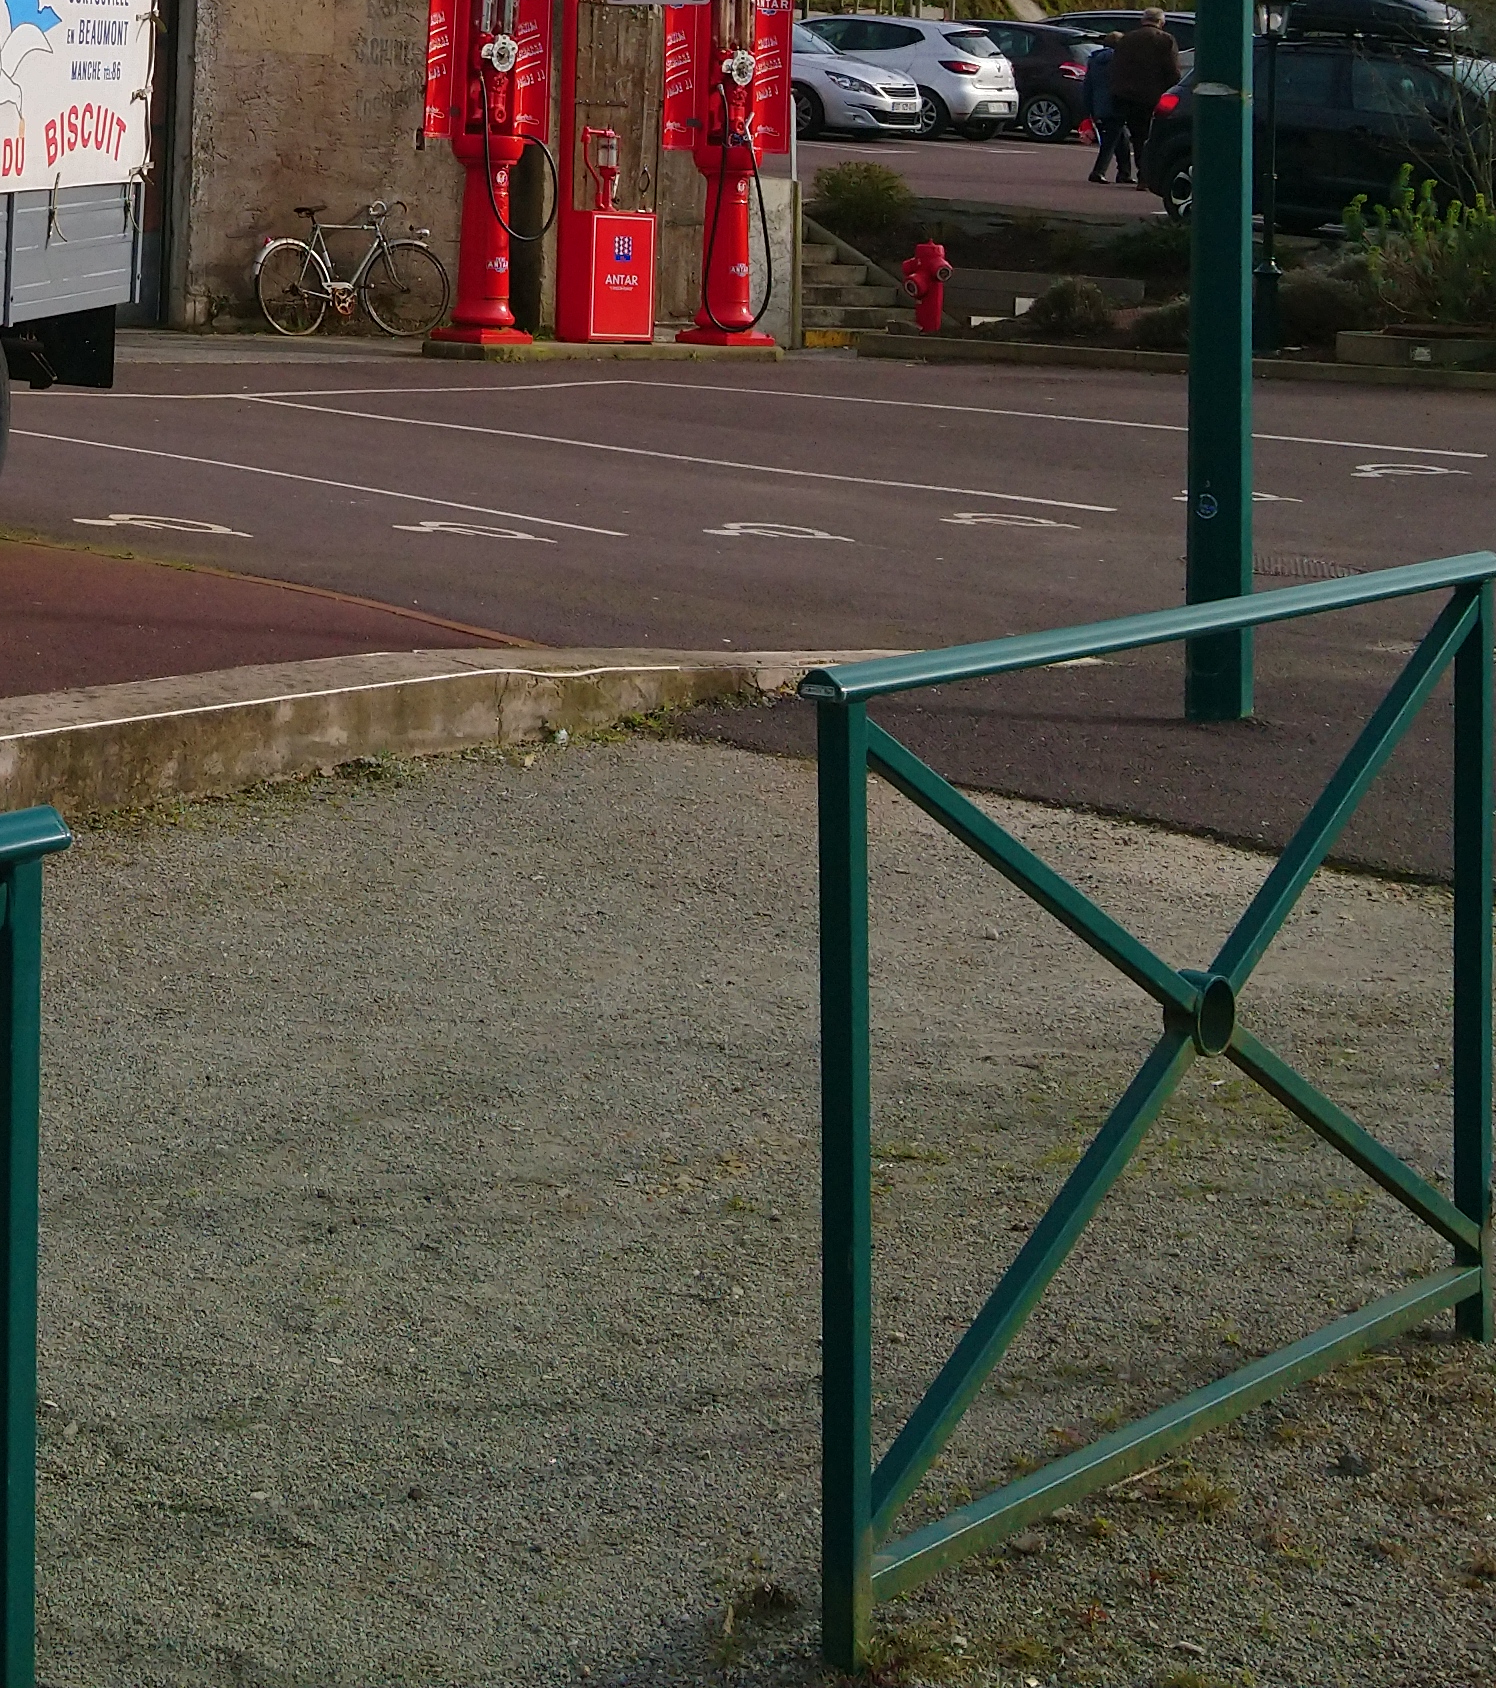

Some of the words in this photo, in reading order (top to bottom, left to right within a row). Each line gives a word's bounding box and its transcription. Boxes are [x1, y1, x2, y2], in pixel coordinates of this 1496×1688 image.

[78, 19, 129, 46] BEAUMONT
[71, 61, 102, 81] MANCHE
[44, 102, 128, 168] BISCUIT
[1, 137, 26, 178] DU
[605, 274, 638, 286] ANTAR
